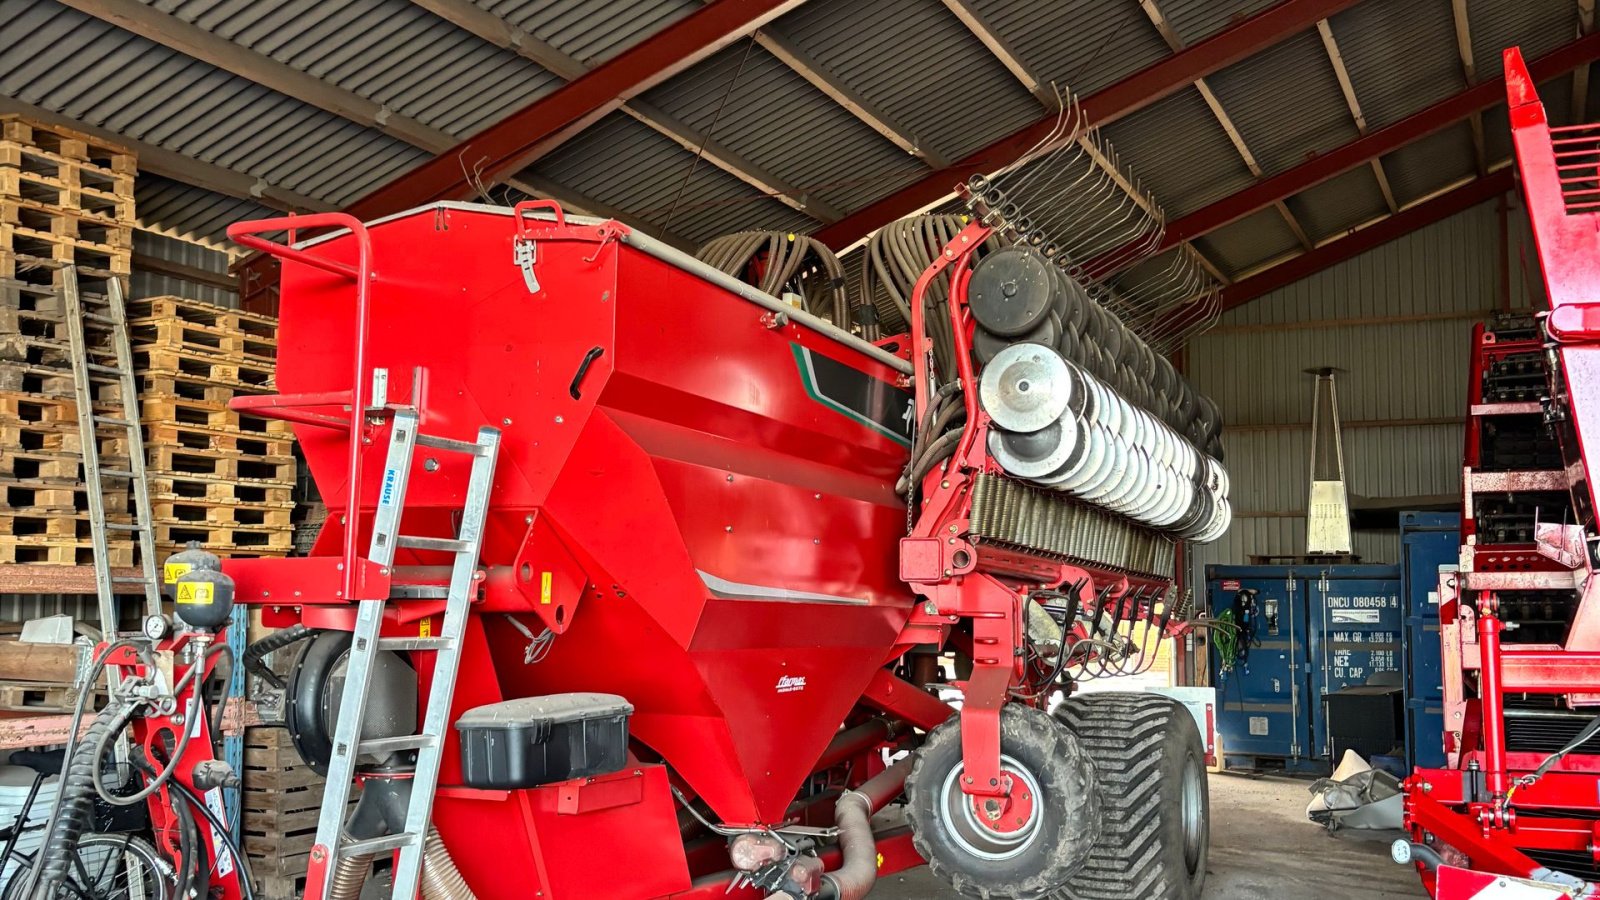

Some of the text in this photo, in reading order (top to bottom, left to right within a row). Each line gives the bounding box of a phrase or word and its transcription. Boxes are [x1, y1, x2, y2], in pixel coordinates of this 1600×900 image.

[382, 470, 395, 505] KRAUSE
[1328, 596, 1350, 608] DNCU
[1353, 596, 1387, 608] 080458
[1349, 667, 1366, 678] CAP.
